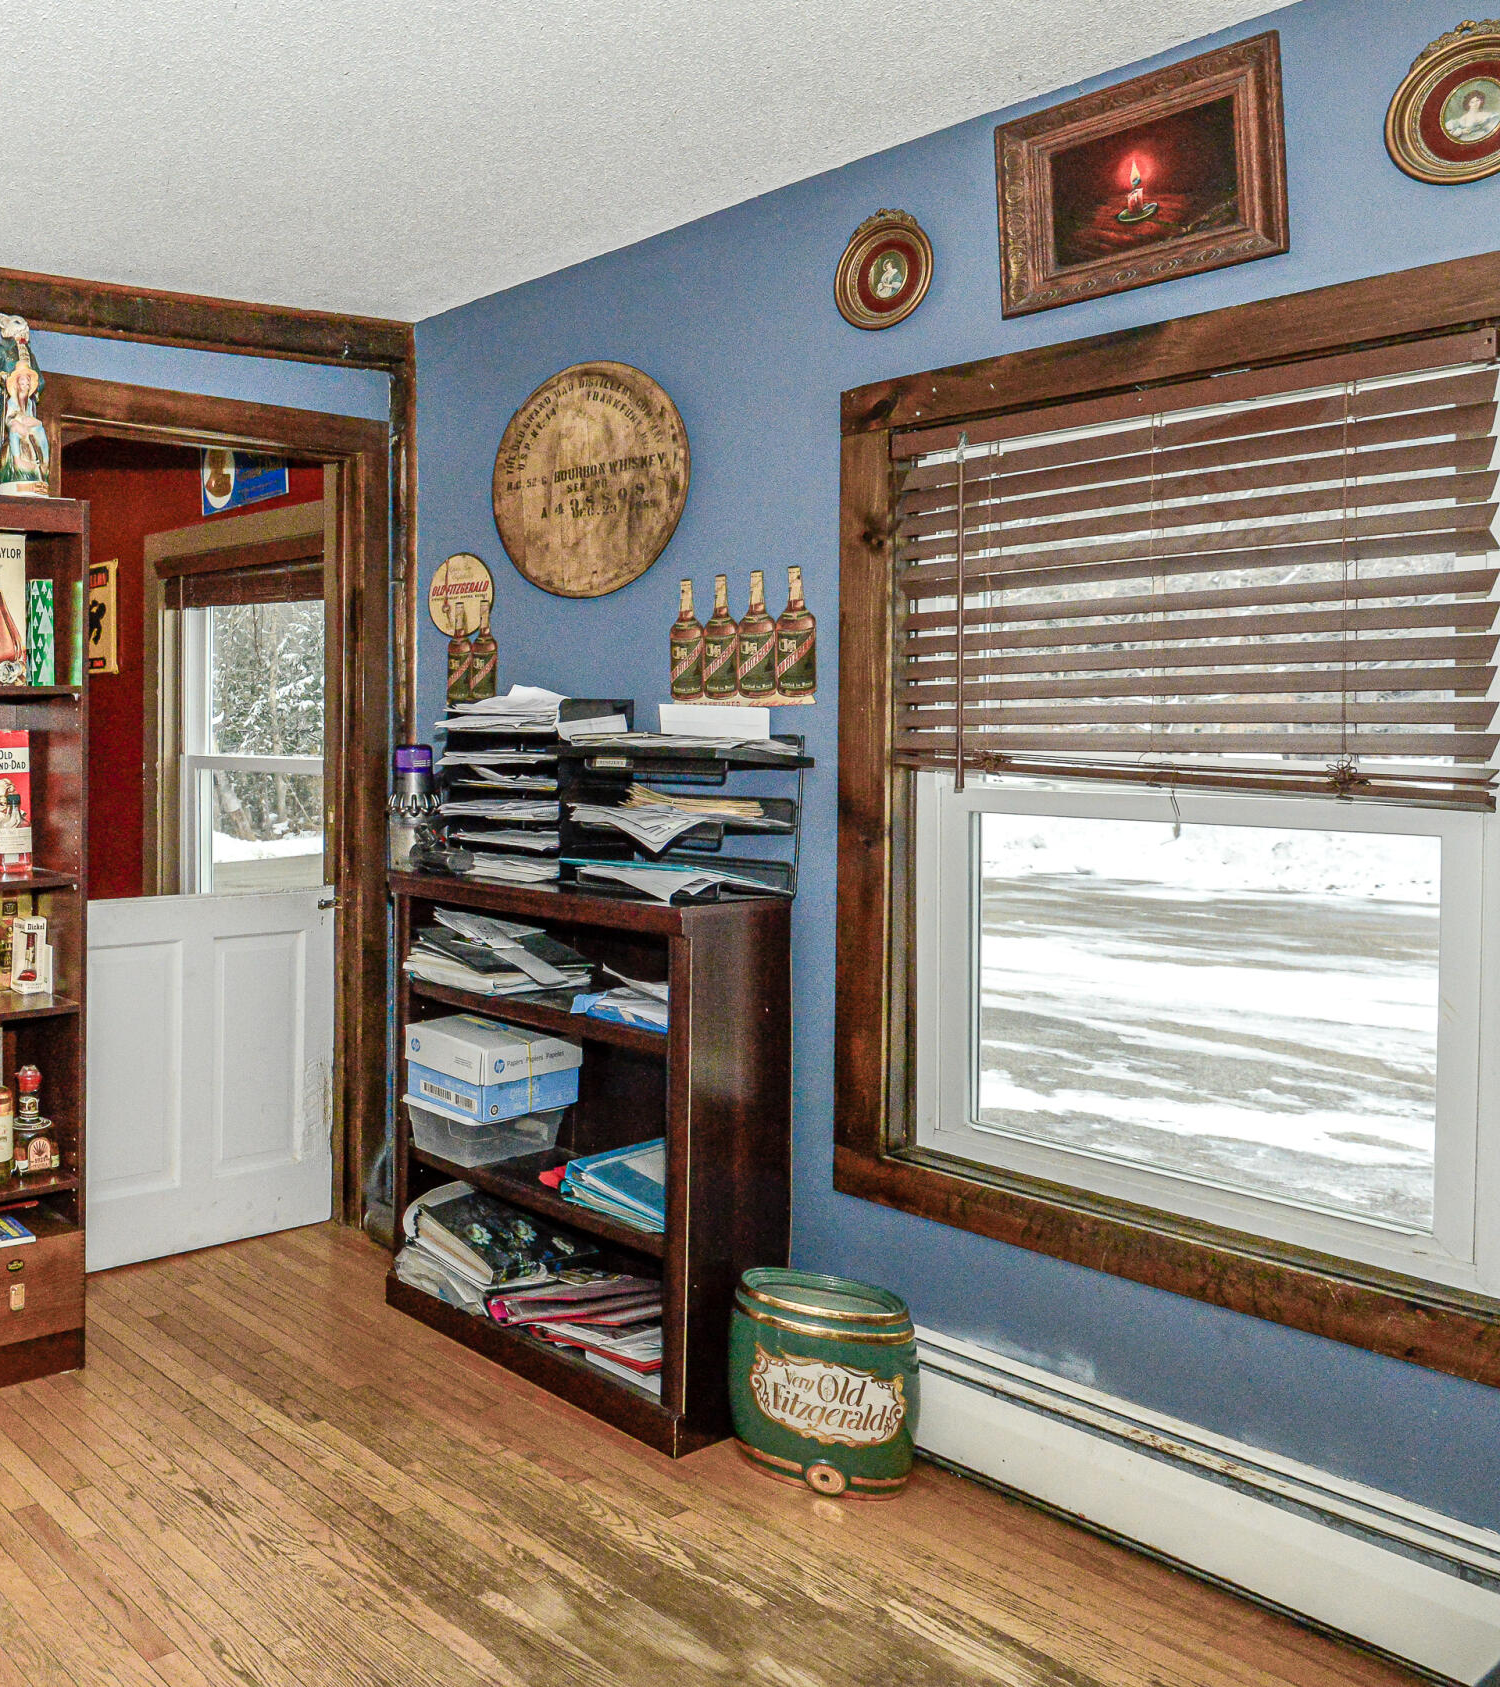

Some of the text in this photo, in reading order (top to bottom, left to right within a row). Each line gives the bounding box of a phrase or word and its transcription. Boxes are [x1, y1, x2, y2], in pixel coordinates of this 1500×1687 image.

[523, 396, 551, 429] GRAND
[554, 462, 606, 484] BOURBON
[608, 452, 665, 474] WHISKEY
[446, 580, 490, 595] FITZGERALD
[28, 923, 45, 931] Dickel
[494, 1059, 506, 1074] hp
[526, 1055, 544, 1064] Ppiers
[784, 1368, 868, 1408] Very Old
[771, 1381, 889, 1433] Fitzgerald
